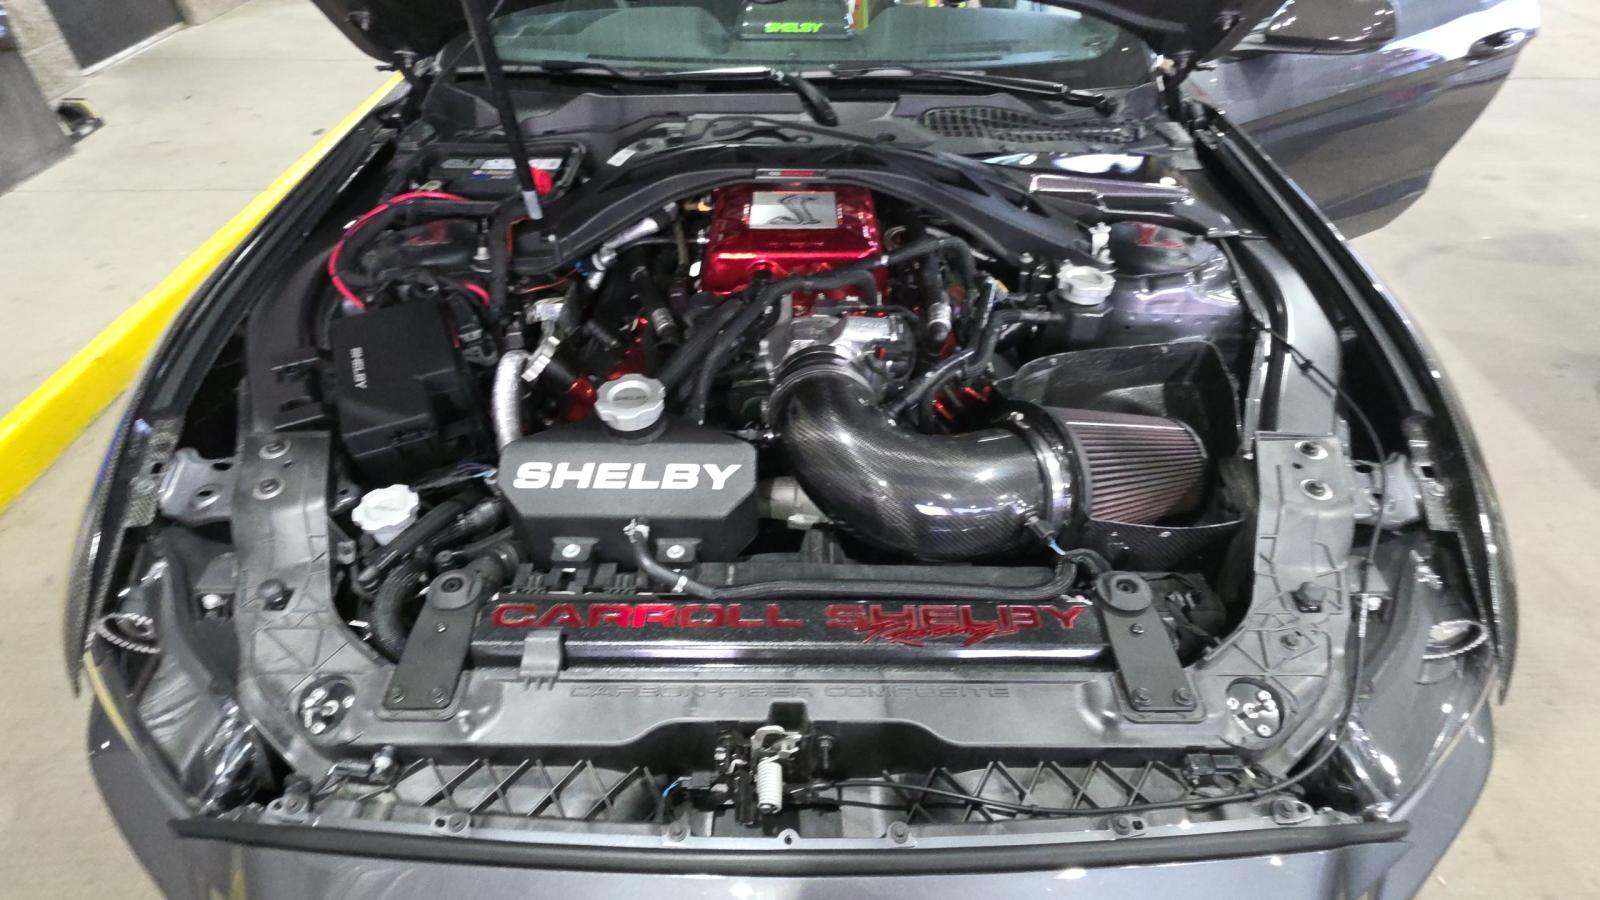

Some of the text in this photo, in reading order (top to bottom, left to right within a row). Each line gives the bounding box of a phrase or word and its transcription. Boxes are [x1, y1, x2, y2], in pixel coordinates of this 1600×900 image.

[349, 346, 368, 389] SHELBY
[512, 461, 743, 490] SHELBY
[491, 602, 1085, 630] CARROLL SHELBY
[824, 686, 1010, 698] COMPOSITE
